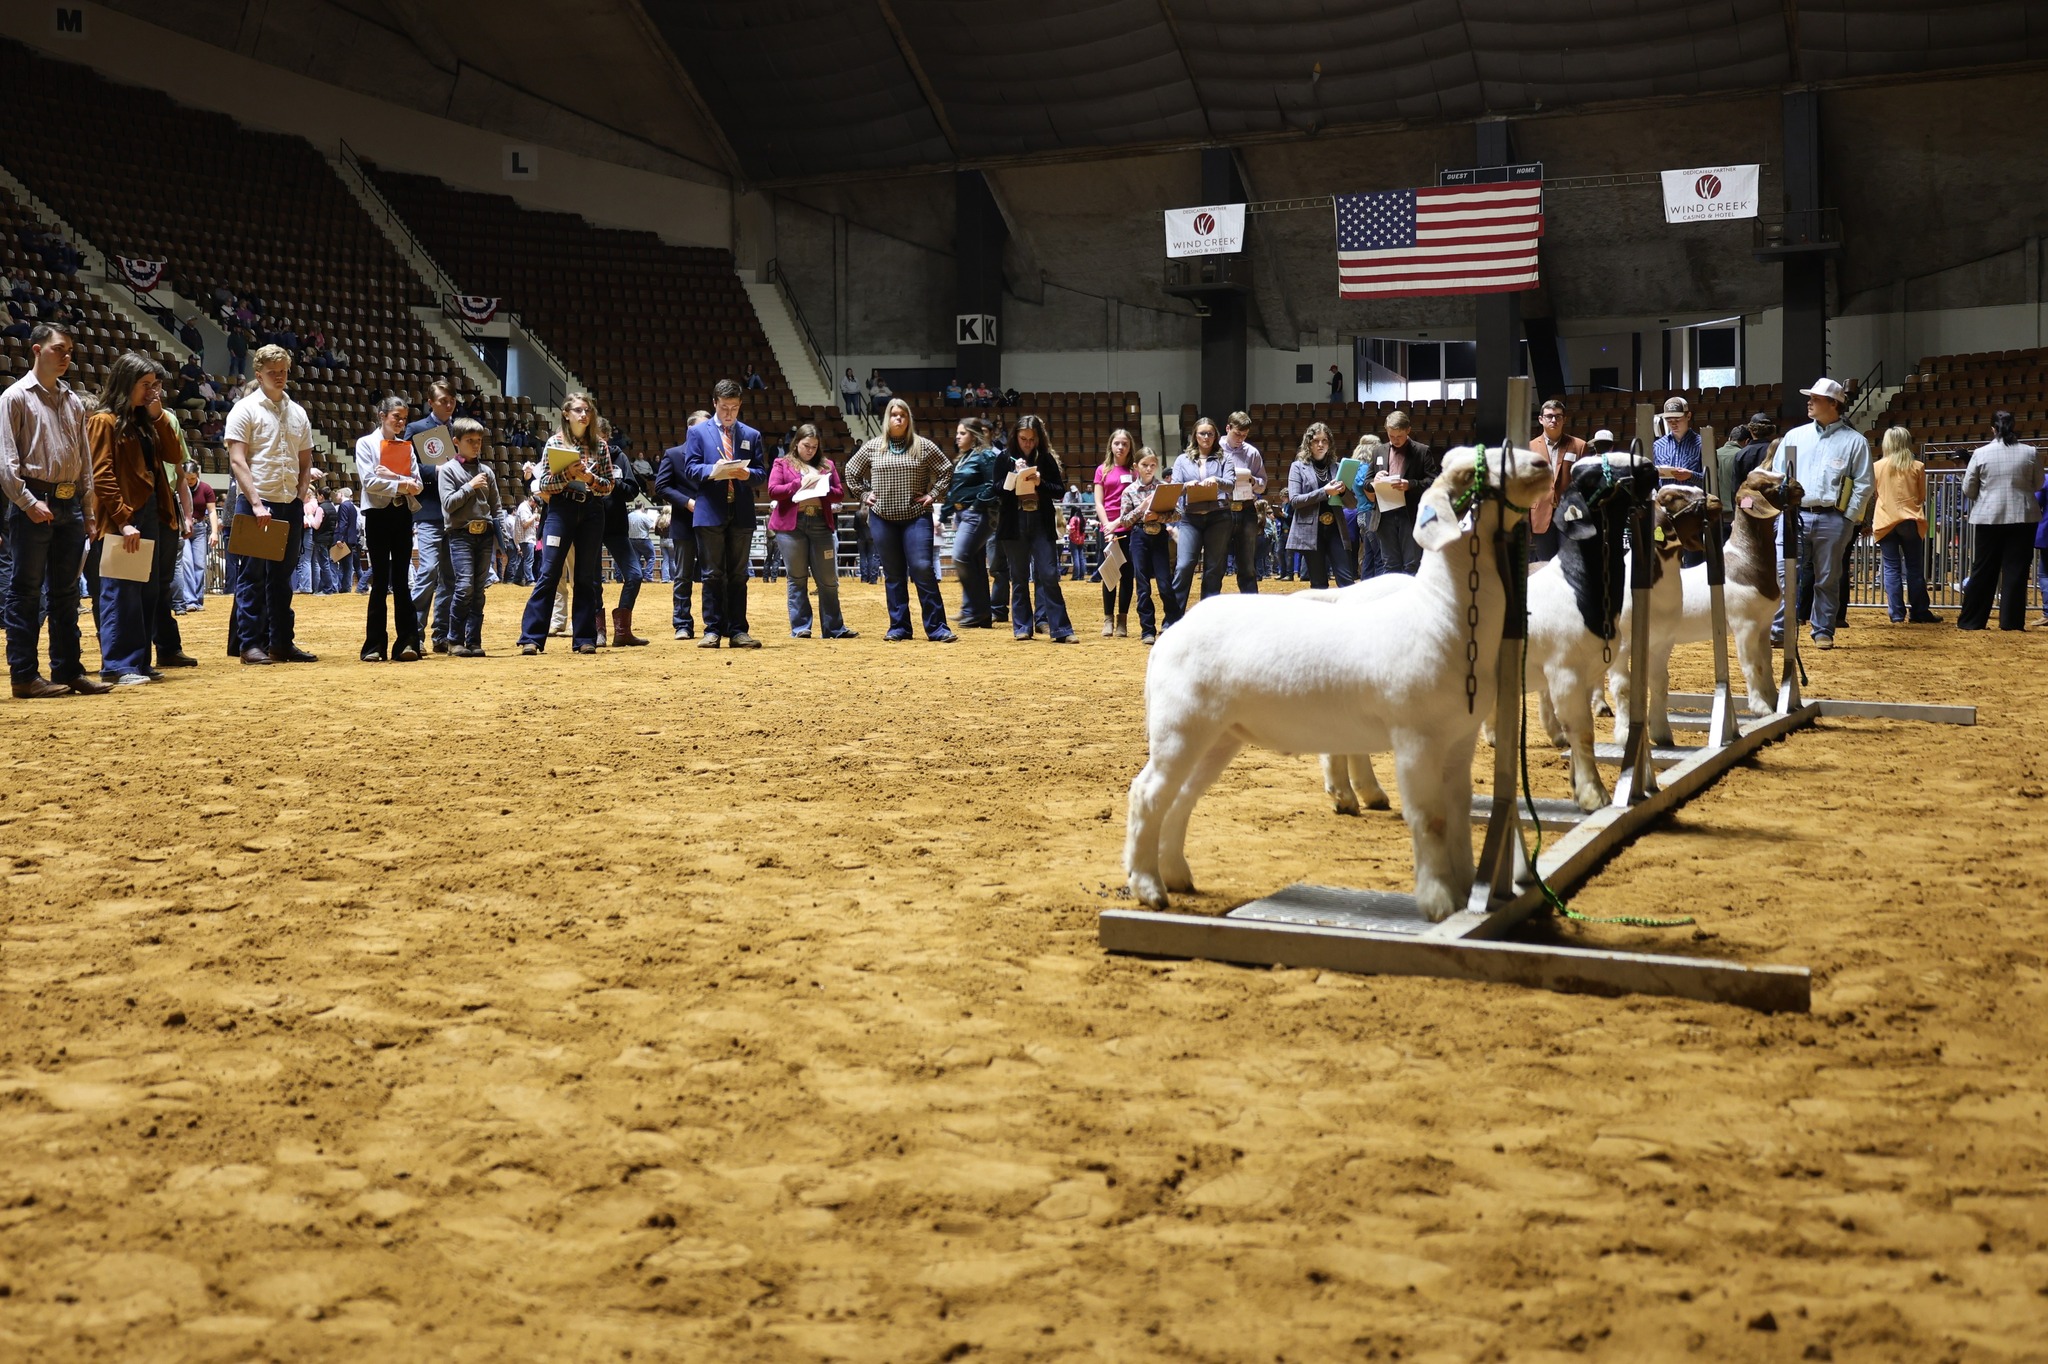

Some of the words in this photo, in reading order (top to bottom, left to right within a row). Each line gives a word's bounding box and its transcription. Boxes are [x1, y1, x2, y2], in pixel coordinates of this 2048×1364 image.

[57, 8, 82, 32] M
[512, 152, 528, 173] L
[1446, 172, 1468, 180] GUEST
[1670, 204, 1704, 214] WIND
[1707, 201, 1748, 211] CREEK
[1173, 240, 1201, 249] WIND
[1204, 237, 1236, 247] CREEK
[960, 318, 979, 341] K
[985, 318, 995, 342] K
